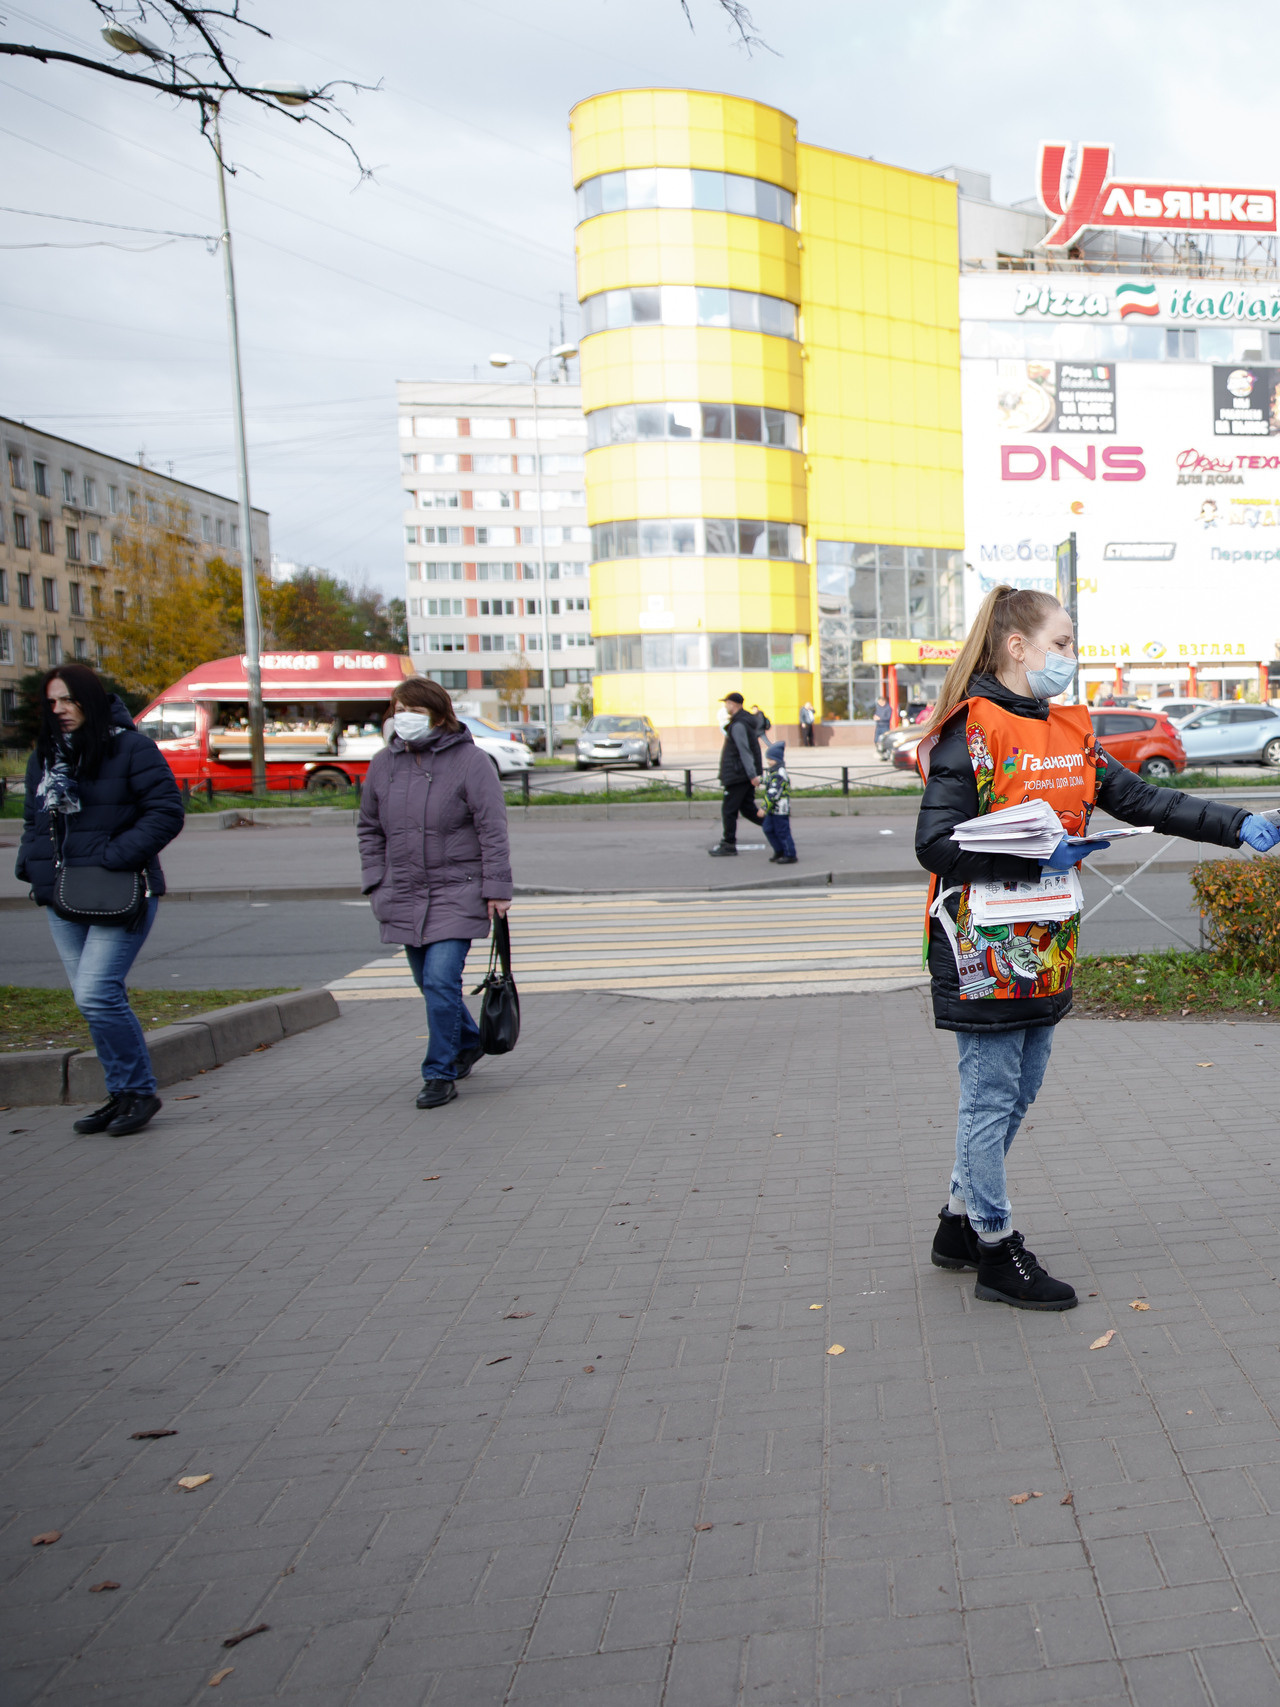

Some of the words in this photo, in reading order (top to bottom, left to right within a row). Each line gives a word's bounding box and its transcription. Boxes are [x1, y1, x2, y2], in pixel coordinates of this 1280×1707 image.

[1014, 283, 1109, 317] Pizza
[1000, 445, 1146, 481] DNS
[1176, 474, 1203, 486] ДЛЯ
[1205, 474, 1245, 487] ДОМА
[1178, 642, 1247, 657] ВЗГЛЯД
[333, 655, 387, 670] РЫБА
[1021, 753, 1084, 773] Гаамарт
[1023, 778, 1055, 791] ТОВАРЫ
[1056, 777, 1068, 790] ДЛЯ
